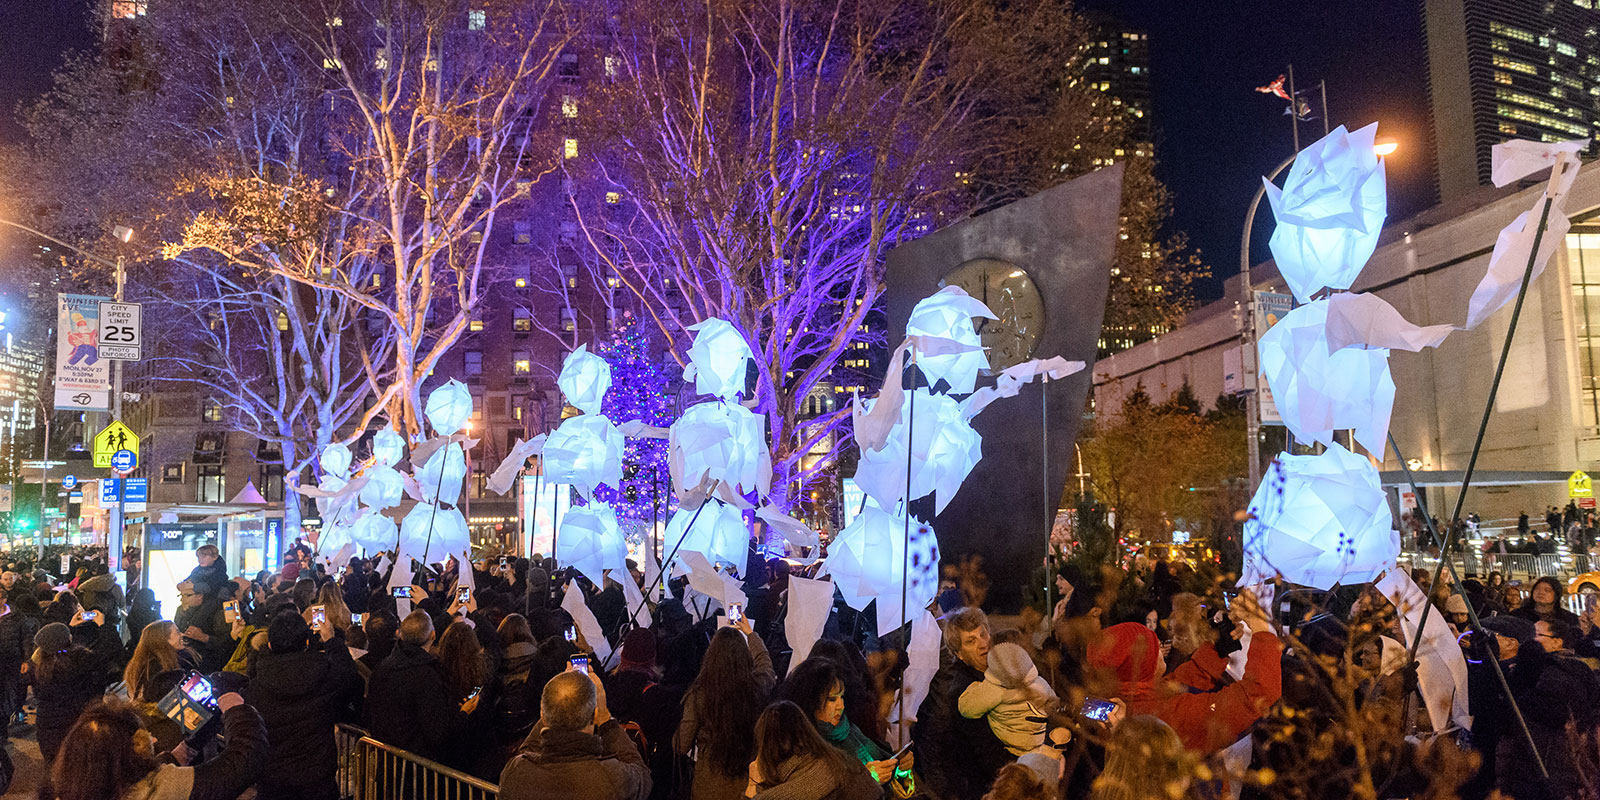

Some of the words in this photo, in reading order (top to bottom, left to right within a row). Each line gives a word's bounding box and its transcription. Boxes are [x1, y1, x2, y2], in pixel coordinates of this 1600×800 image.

[62, 303, 80, 312] EVE
[1258, 303, 1273, 312] EVE
[104, 326, 135, 342] 25
